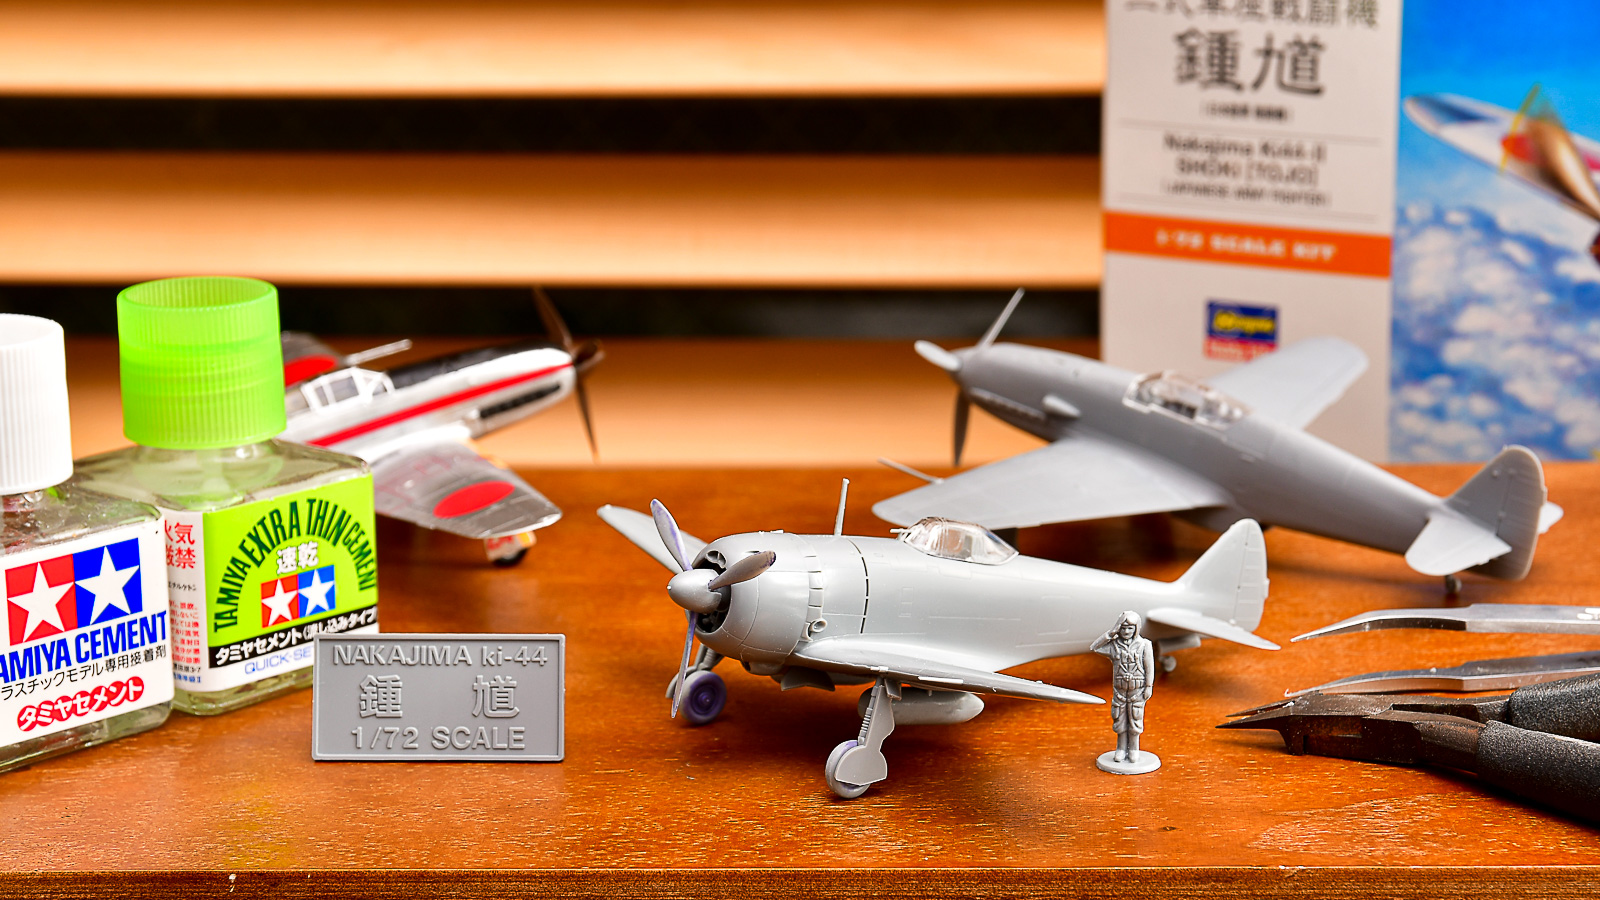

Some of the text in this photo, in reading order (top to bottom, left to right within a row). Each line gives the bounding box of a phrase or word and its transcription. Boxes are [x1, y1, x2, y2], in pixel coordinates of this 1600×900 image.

[1174, 27, 1326, 96] 鍾馗
[1210, 232, 1287, 257] SCALE
[1293, 241, 1338, 262] KIT
[214, 498, 377, 633] TAMIYA EXTRA THIN CEMENT
[276, 541, 319, 574] 速乾
[0, 610, 167, 684] AMIYA CEMENT
[245, 642, 314, 676] QUICK-SE
[332, 644, 548, 667] NAKAJIMA ki-44
[0, 643, 167, 701] ラスチックモデル専用接着剤
[19, 676, 144, 729] タミヤセメント
[359, 674, 520, 718] 鍾 馗
[350, 726, 526, 750] 1/72 SCALE
